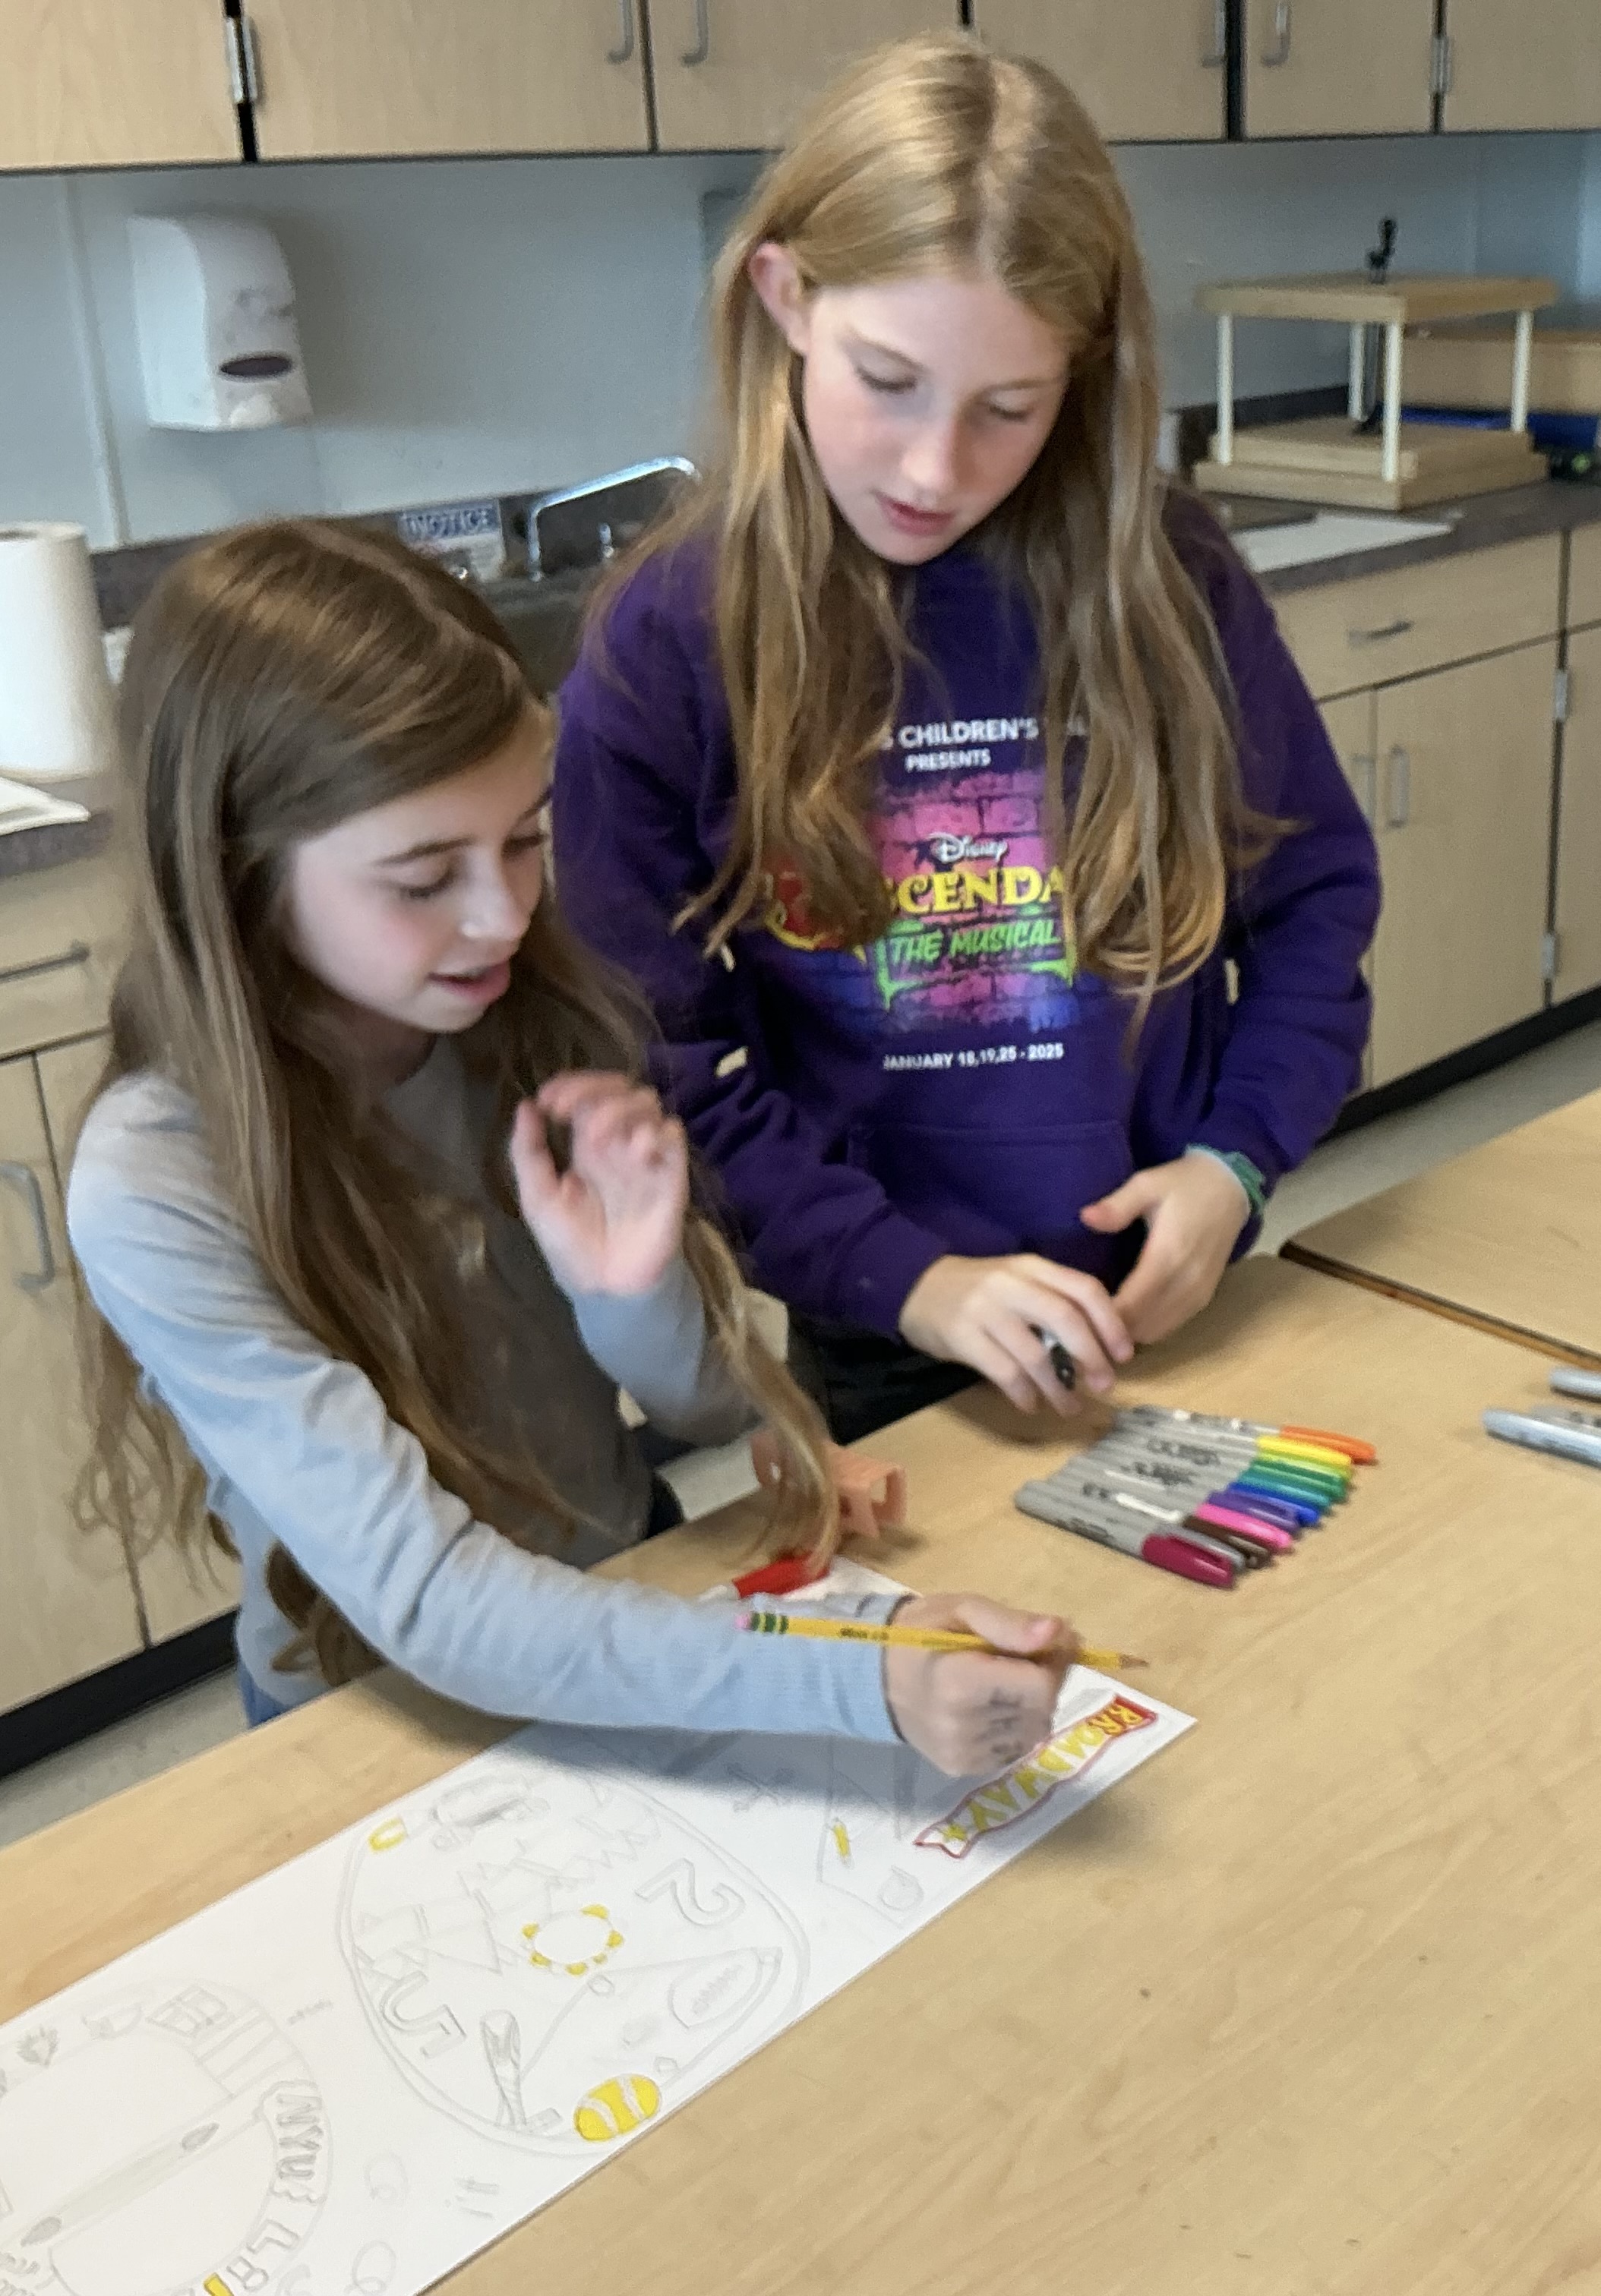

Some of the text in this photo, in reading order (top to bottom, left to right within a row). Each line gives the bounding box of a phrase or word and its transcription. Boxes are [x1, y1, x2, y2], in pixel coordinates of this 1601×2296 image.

[898, 718, 1039, 749] CHILDREN'S
[905, 748, 990, 773] PRESENTS
[927, 832, 1008, 863] Disney
[886, 866, 1066, 914] CENDA
[890, 919, 1062, 966] THE MUSICAL
[883, 1052, 953, 1071] JANUARY
[1028, 1042, 1063, 1061] 2025
